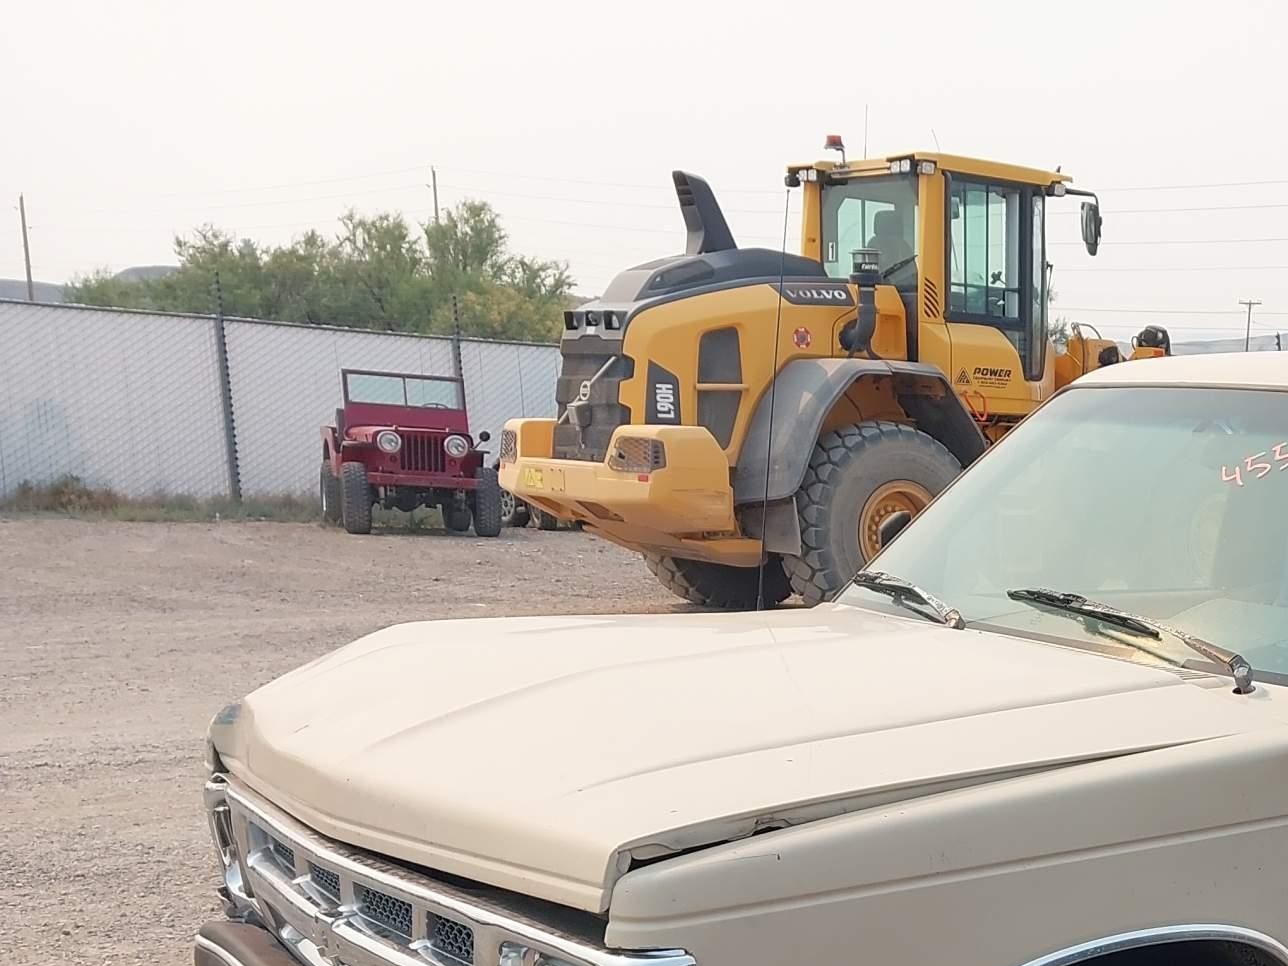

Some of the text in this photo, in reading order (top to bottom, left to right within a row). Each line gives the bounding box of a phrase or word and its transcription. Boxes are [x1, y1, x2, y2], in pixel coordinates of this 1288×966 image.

[786, 289, 847, 300] VOLVO
[973, 367, 1012, 378] POWER
[656, 383, 675, 418] L90H
